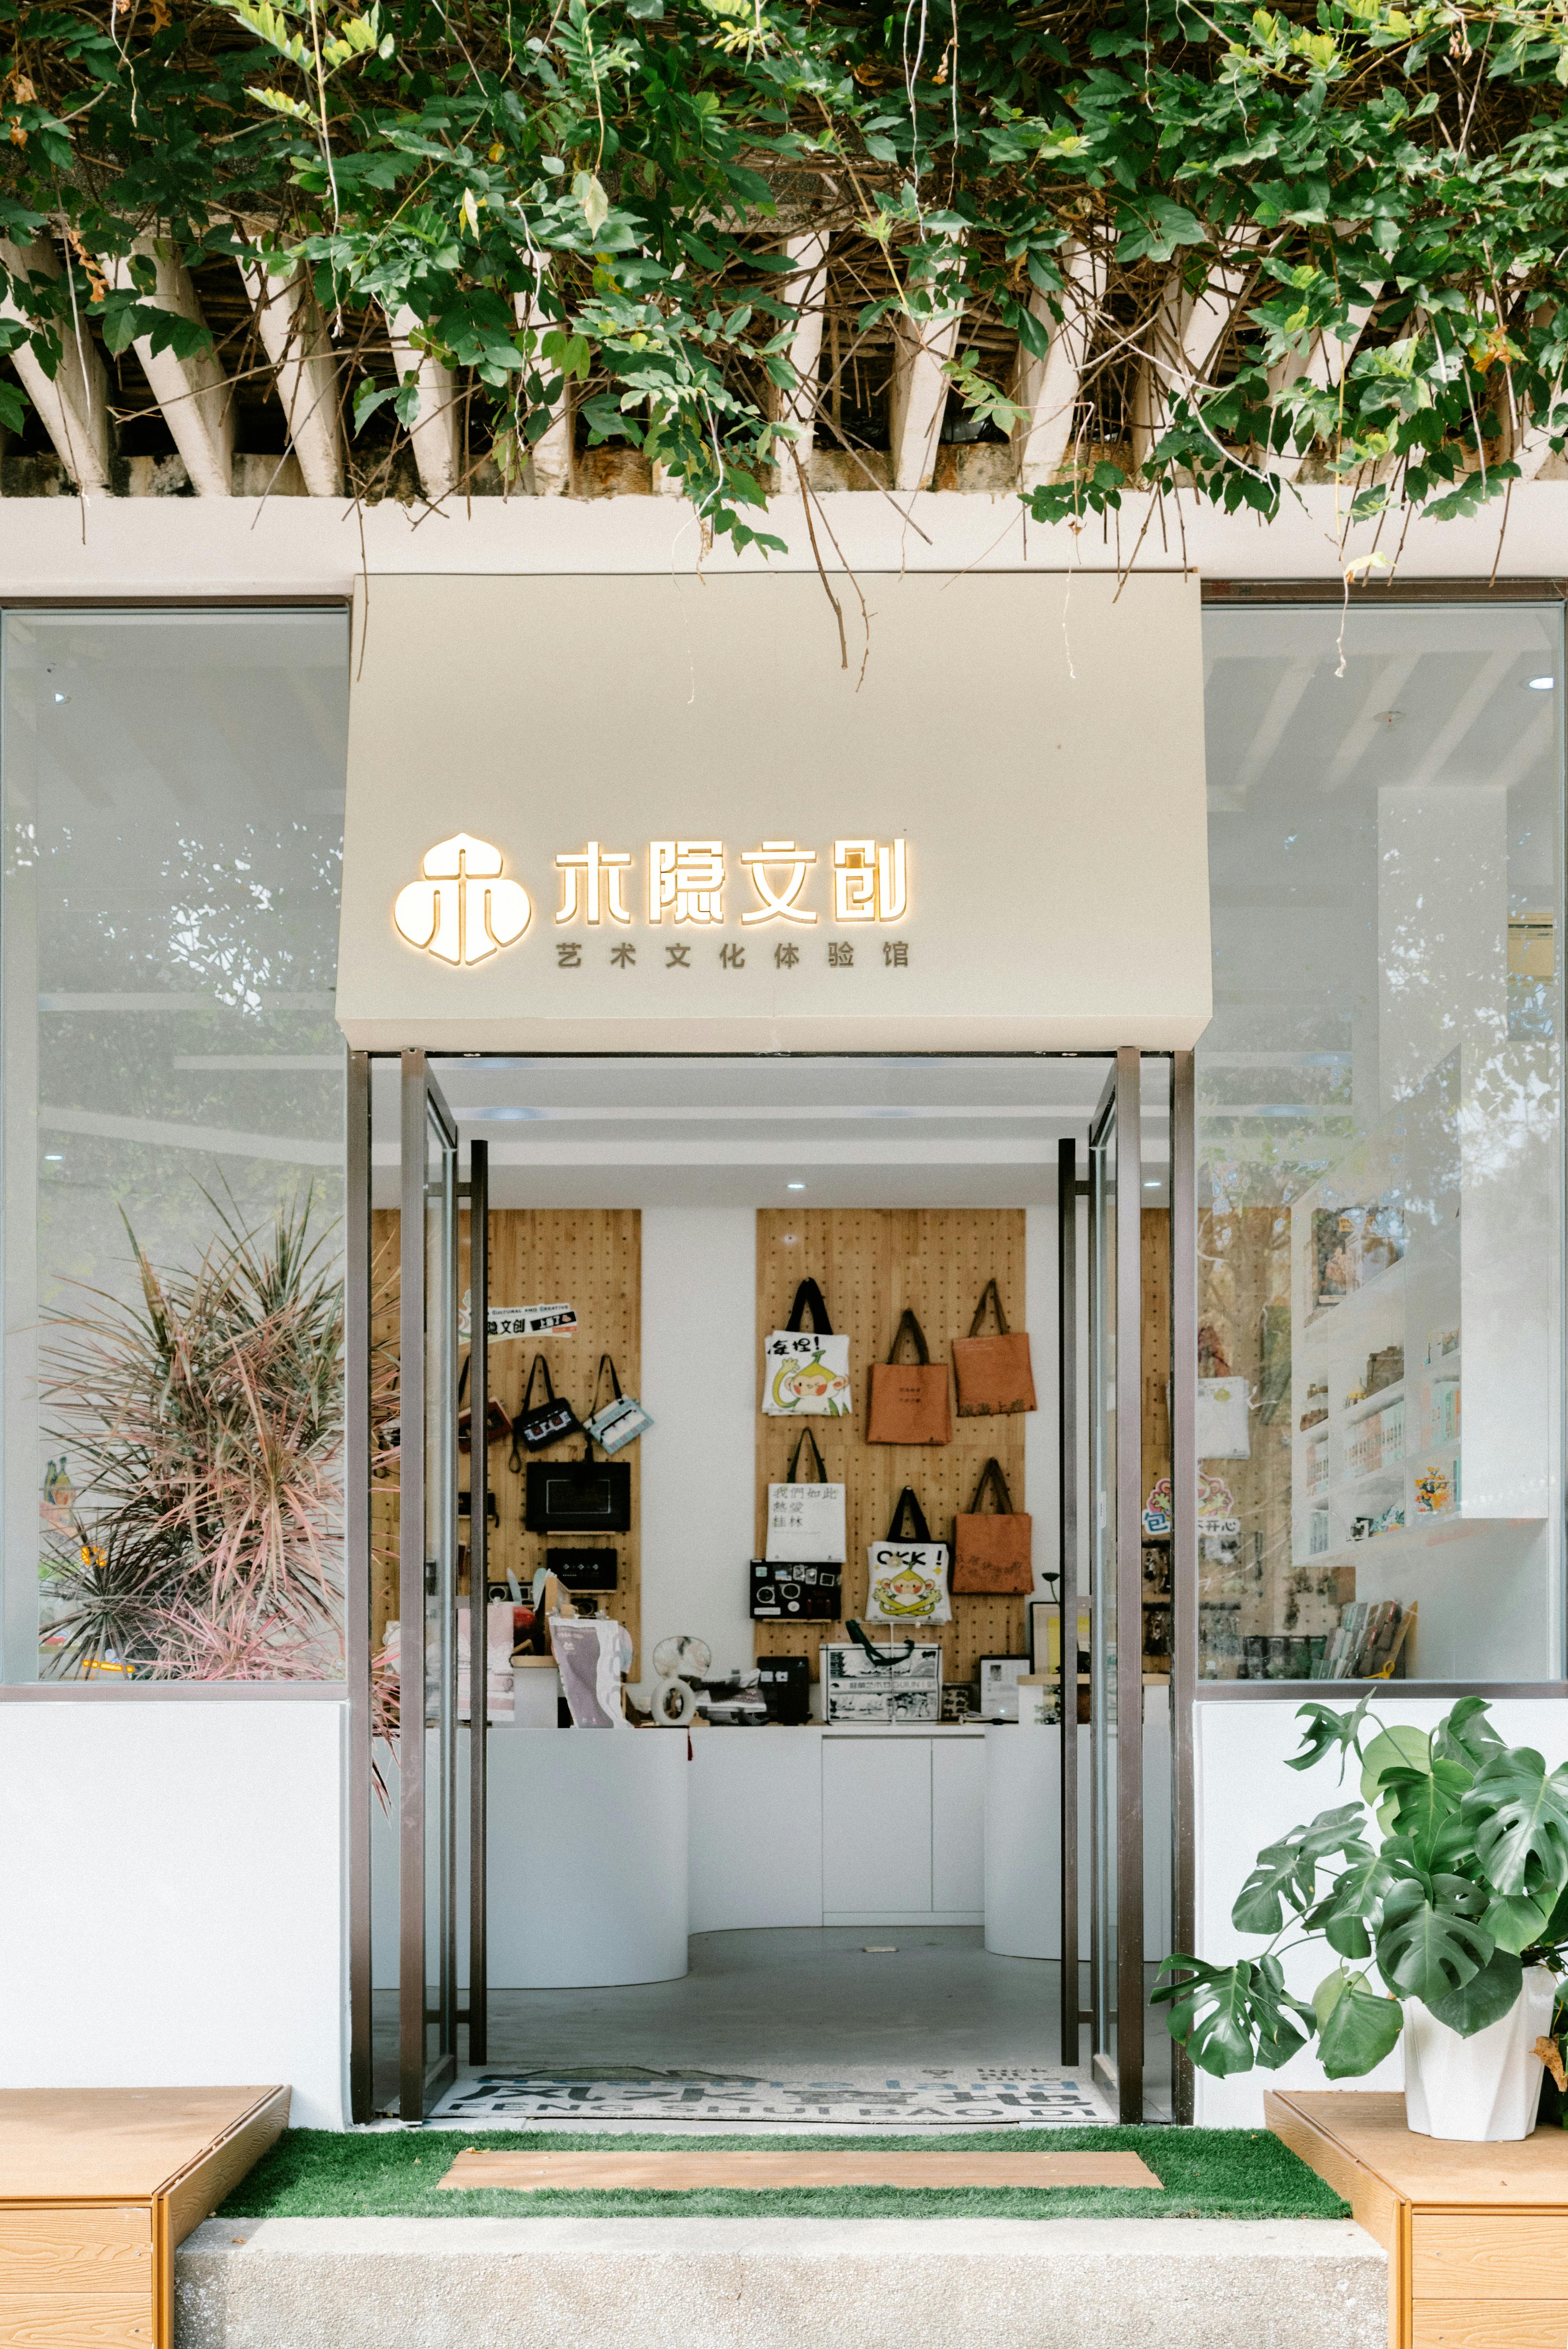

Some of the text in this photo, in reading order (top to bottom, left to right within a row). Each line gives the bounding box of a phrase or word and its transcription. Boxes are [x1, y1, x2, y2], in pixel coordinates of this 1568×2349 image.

[555, 838, 907, 926] 木隐文创
[555, 941, 909, 969] 艺术文化体验馆
[886, 2080, 1079, 2091] land
